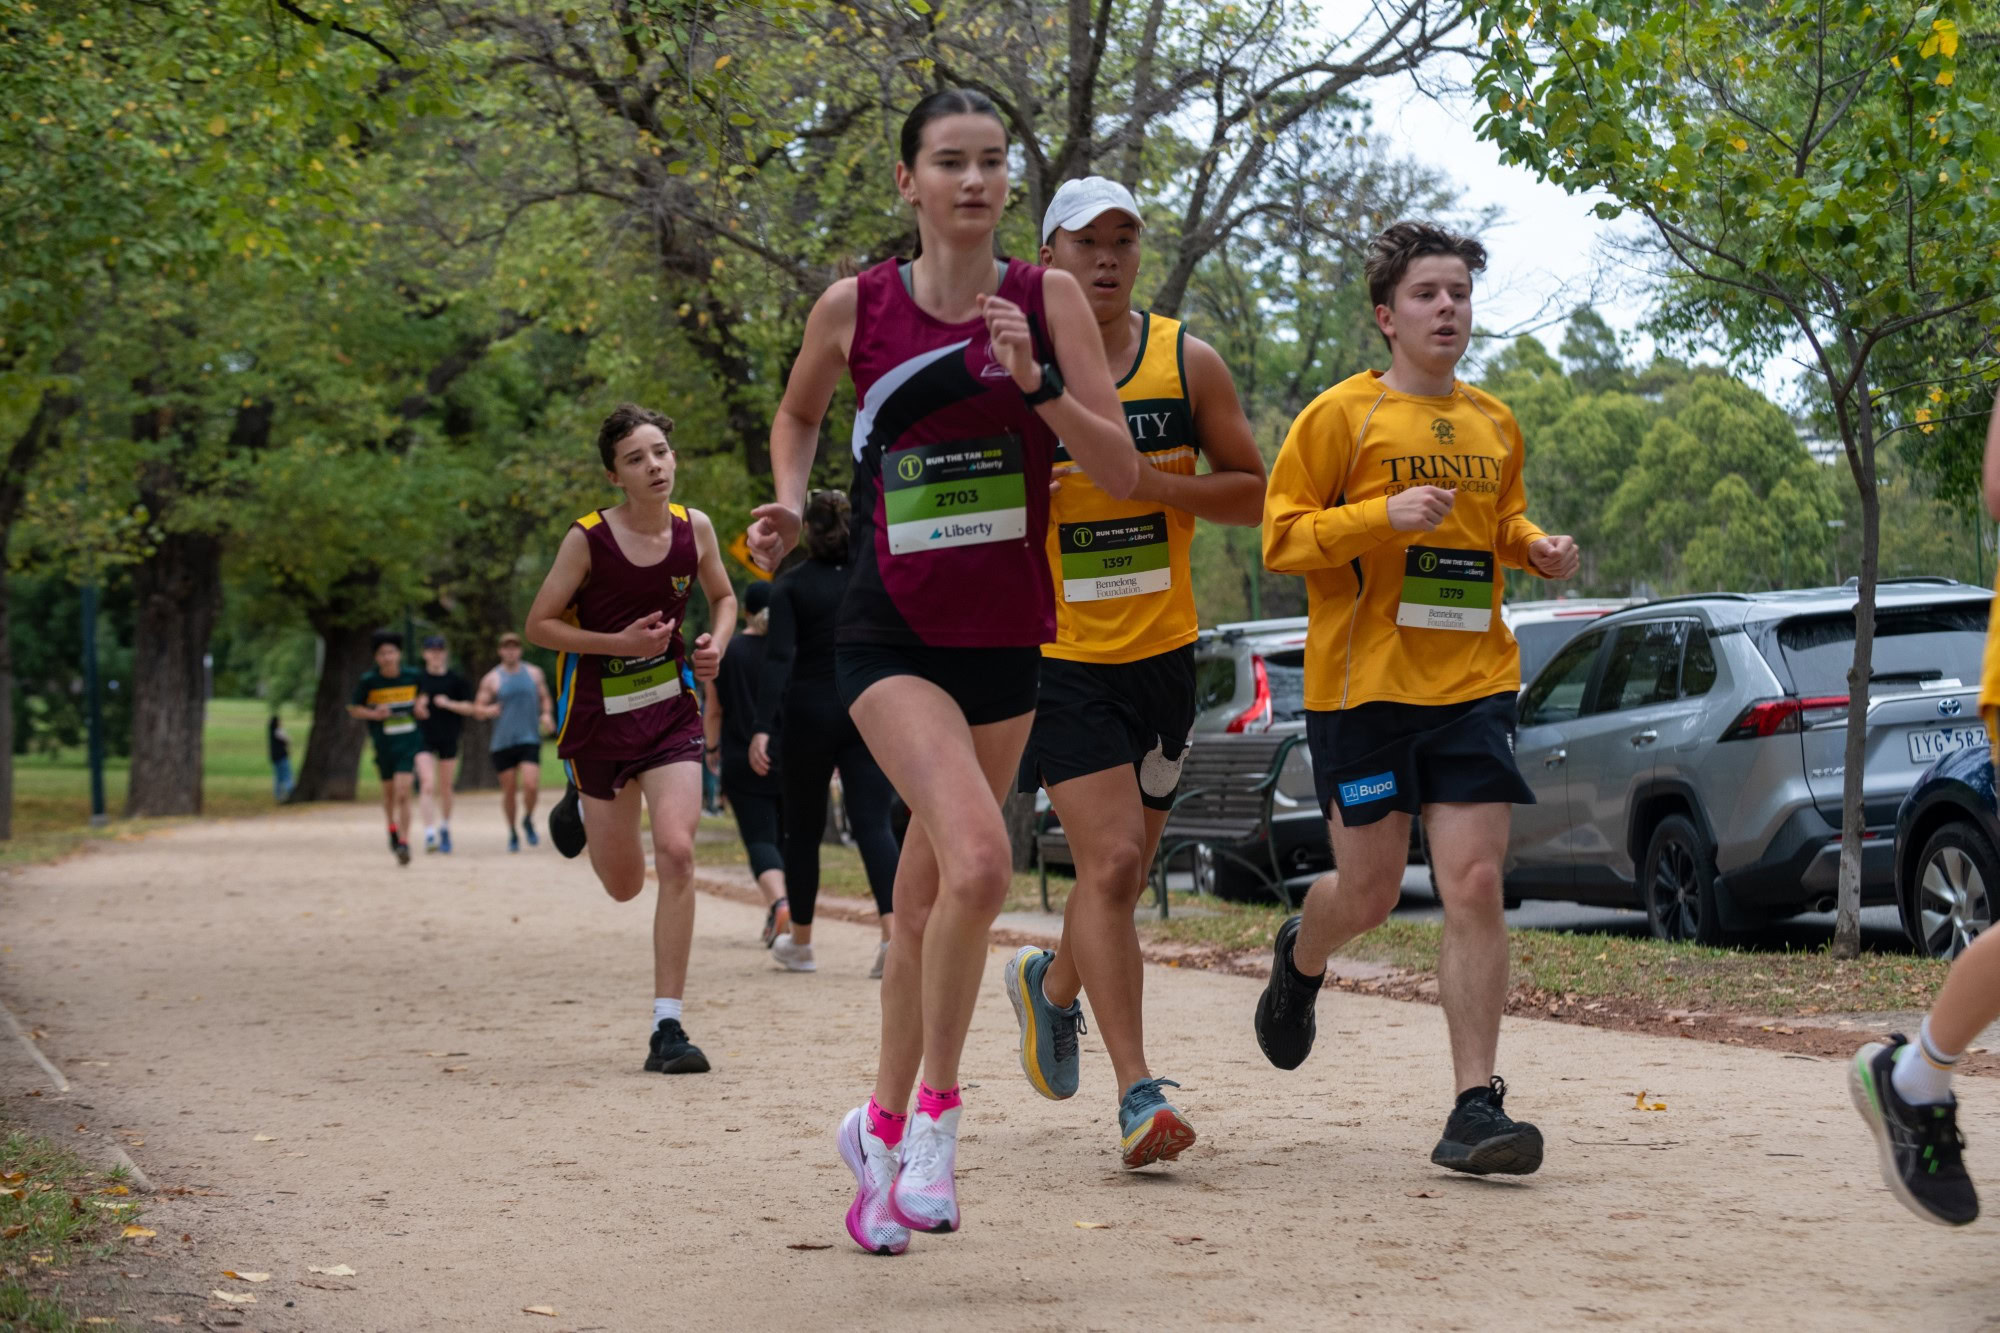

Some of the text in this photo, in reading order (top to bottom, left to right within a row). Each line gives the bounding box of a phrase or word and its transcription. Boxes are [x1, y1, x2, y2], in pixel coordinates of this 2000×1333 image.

[926, 455, 945, 466] RUN
[946, 453, 963, 463] THE
[964, 451, 982, 460] TAN
[976, 460, 1003, 470] Liberty
[1381, 454, 1501, 483] TRINITY
[935, 489, 979, 507] 2703
[944, 523, 992, 538] Liberty
[1134, 533, 1154, 541] Liberty
[1102, 555, 1133, 569] 1397
[1096, 577, 1138, 590] Bennelong
[1439, 587, 1464, 600] 1379
[1428, 608, 1464, 621] Bennelong
[1360, 780, 1393, 797] Bupa
